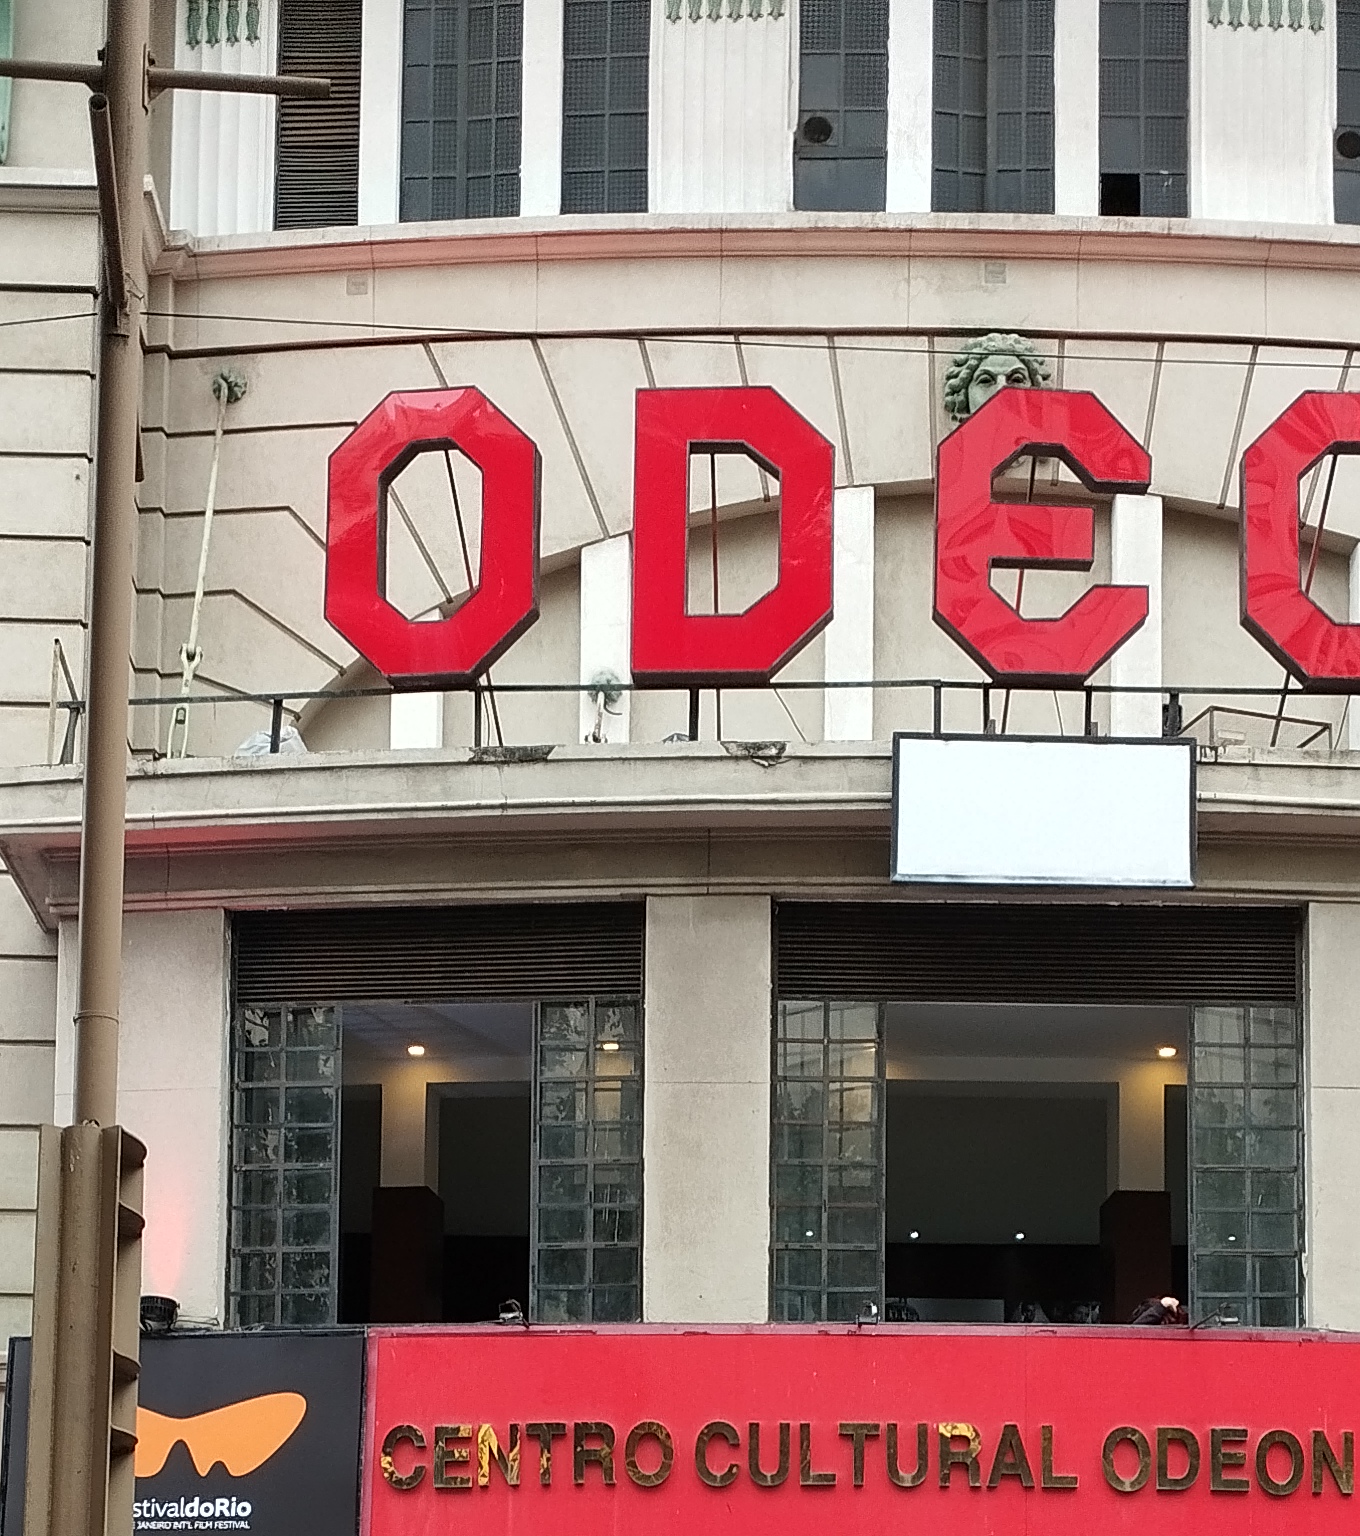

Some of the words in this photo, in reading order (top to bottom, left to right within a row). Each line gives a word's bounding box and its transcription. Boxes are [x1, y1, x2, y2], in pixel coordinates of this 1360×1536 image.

[380, 1421, 674, 1490] CENTRO
[694, 1421, 1079, 1489] CULTURAL
[1101, 1424, 1355, 1496] ODEON
